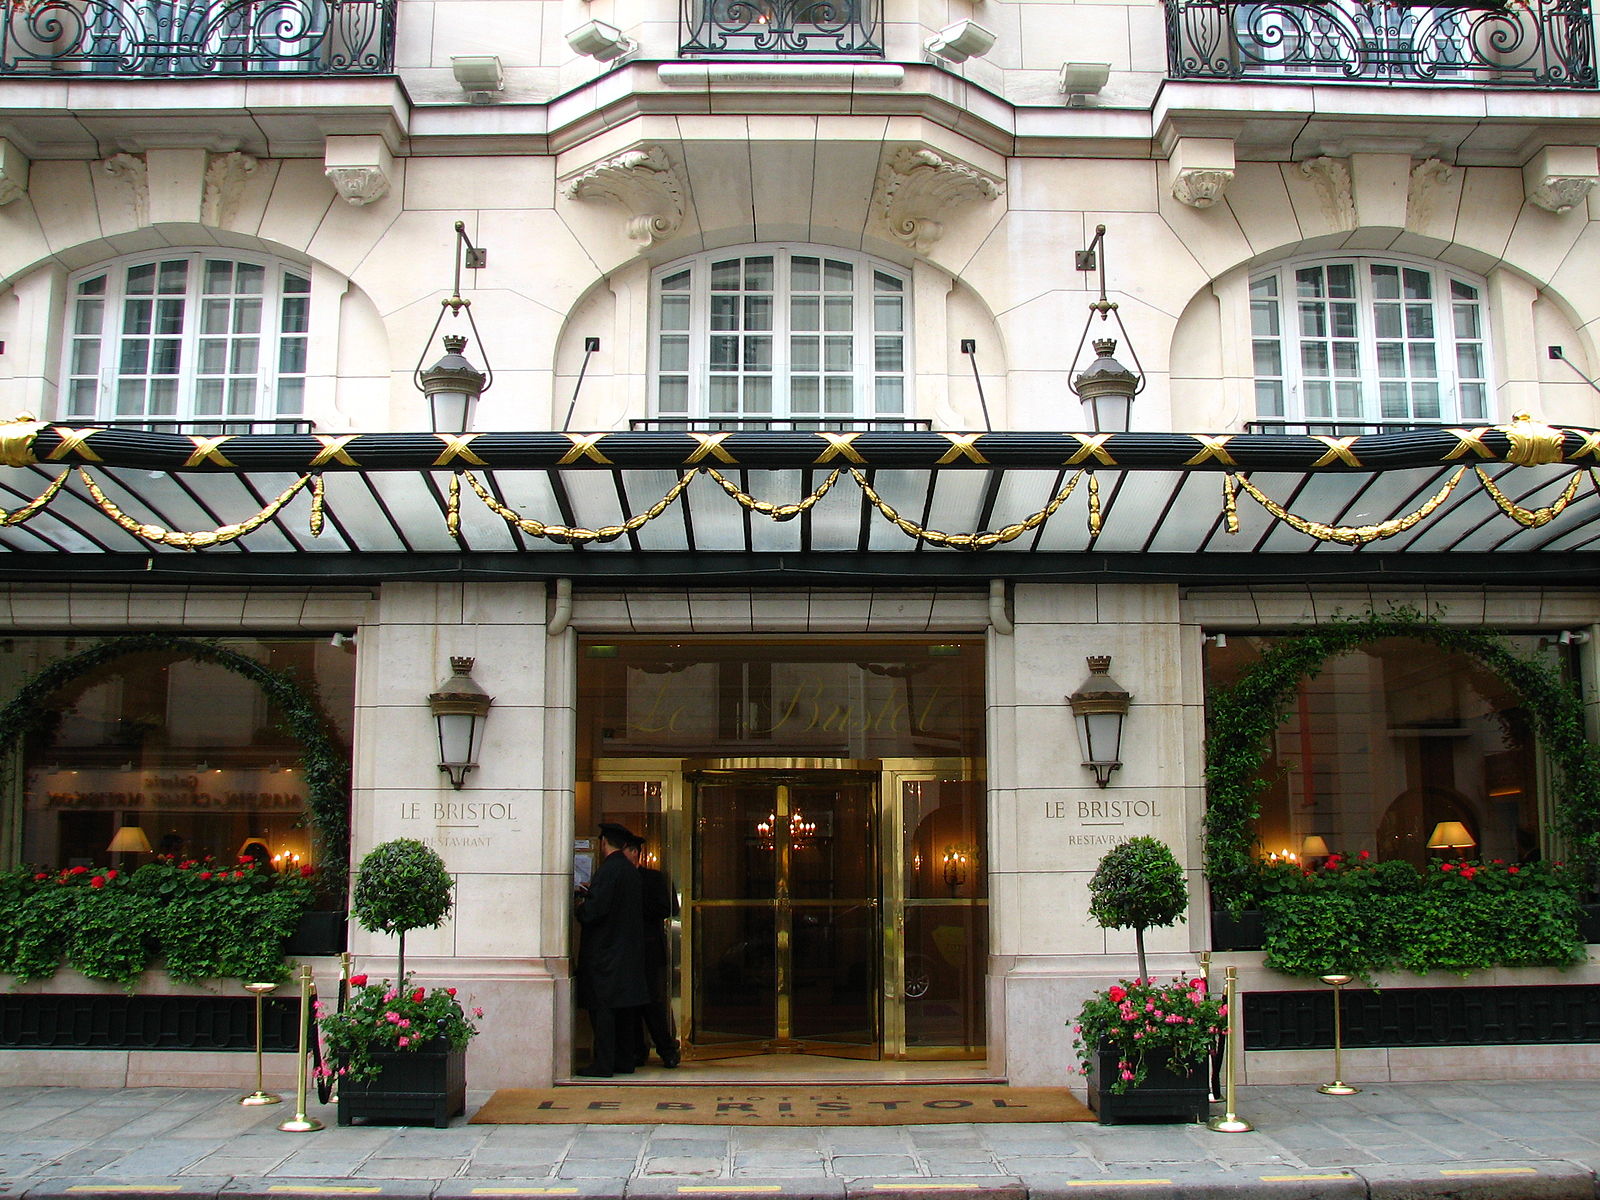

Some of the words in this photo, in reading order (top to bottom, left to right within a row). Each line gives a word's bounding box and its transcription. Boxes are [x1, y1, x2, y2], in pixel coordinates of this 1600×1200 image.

[401, 802, 421, 820] LE
[433, 803, 517, 820] BRISTOL
[1045, 801, 1065, 819] LE
[1078, 800, 1161, 818] BRISTOL
[537, 1101, 622, 1110] LE
[655, 1099, 1028, 1112] BRISTOL
